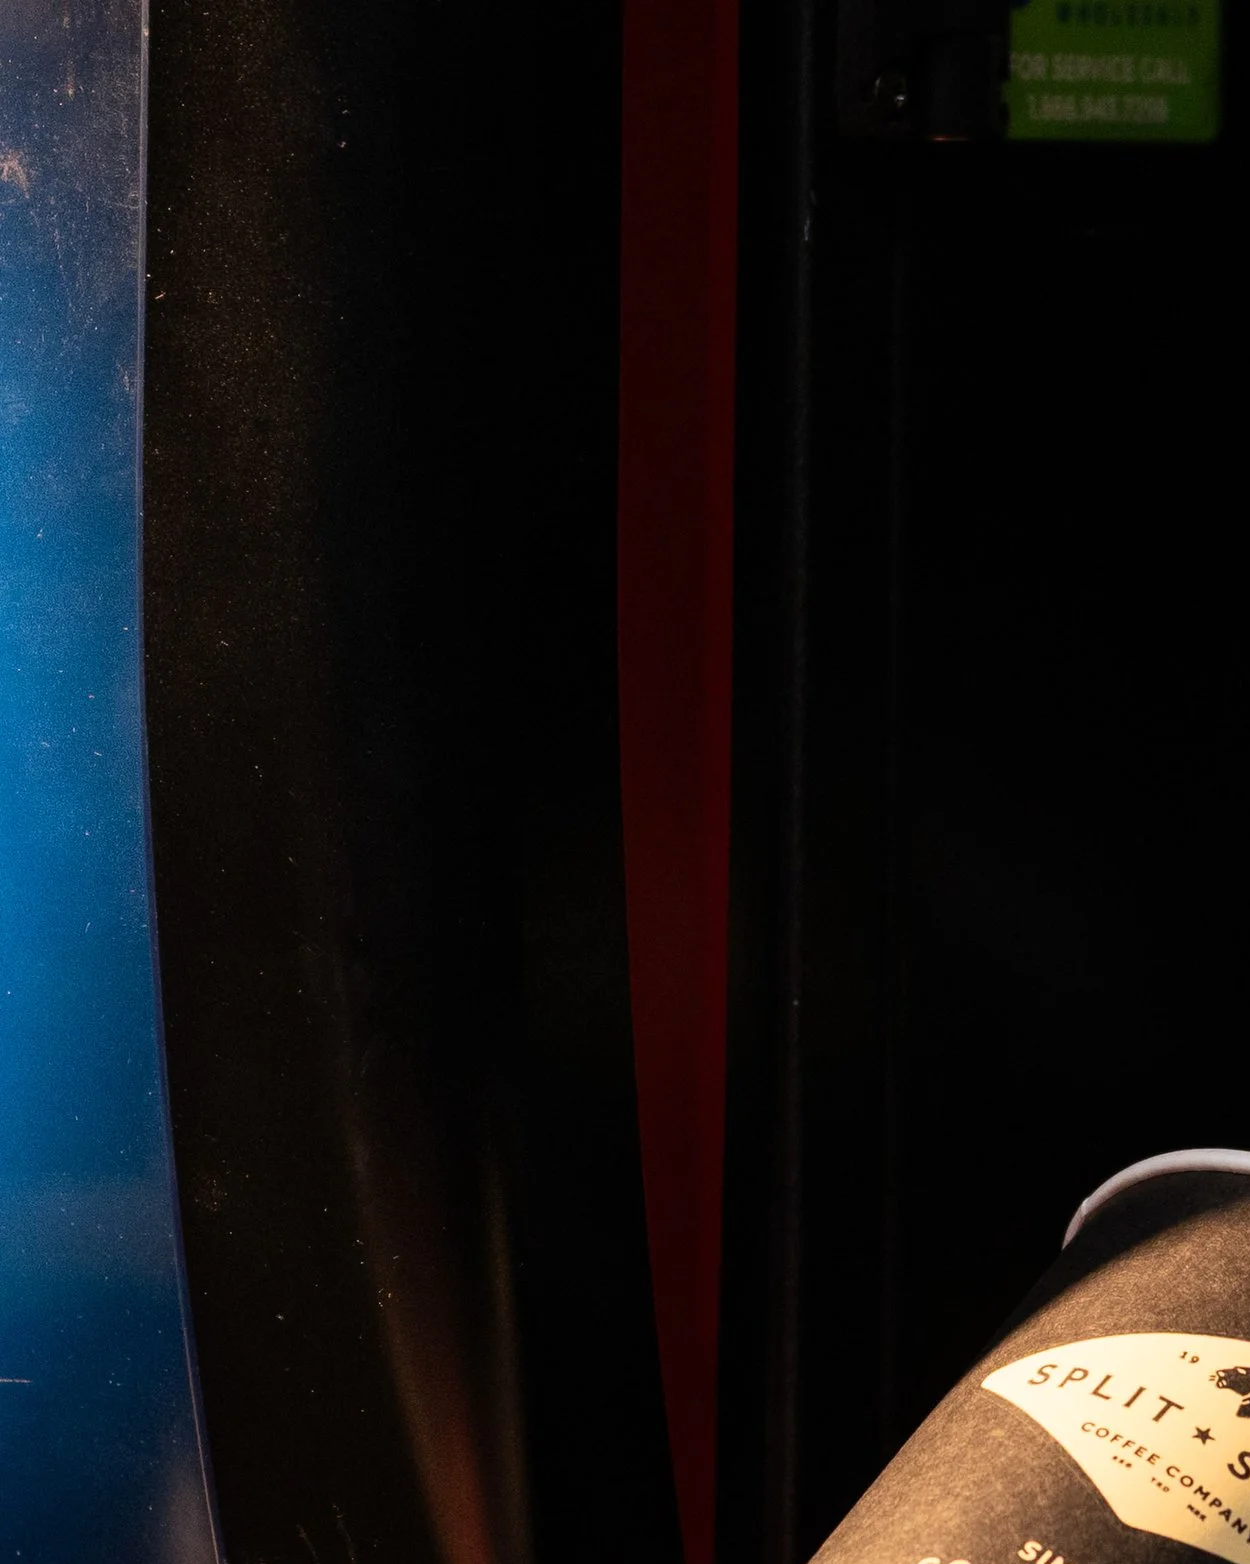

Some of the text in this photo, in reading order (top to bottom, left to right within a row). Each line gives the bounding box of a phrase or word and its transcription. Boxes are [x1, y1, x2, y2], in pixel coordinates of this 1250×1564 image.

[1051, 52, 1136, 84] SERVICE
[1179, 1350, 1201, 1365] 19
[1028, 1363, 1185, 1424] SPLIT
[1081, 1421, 1160, 1466] COFFEE
